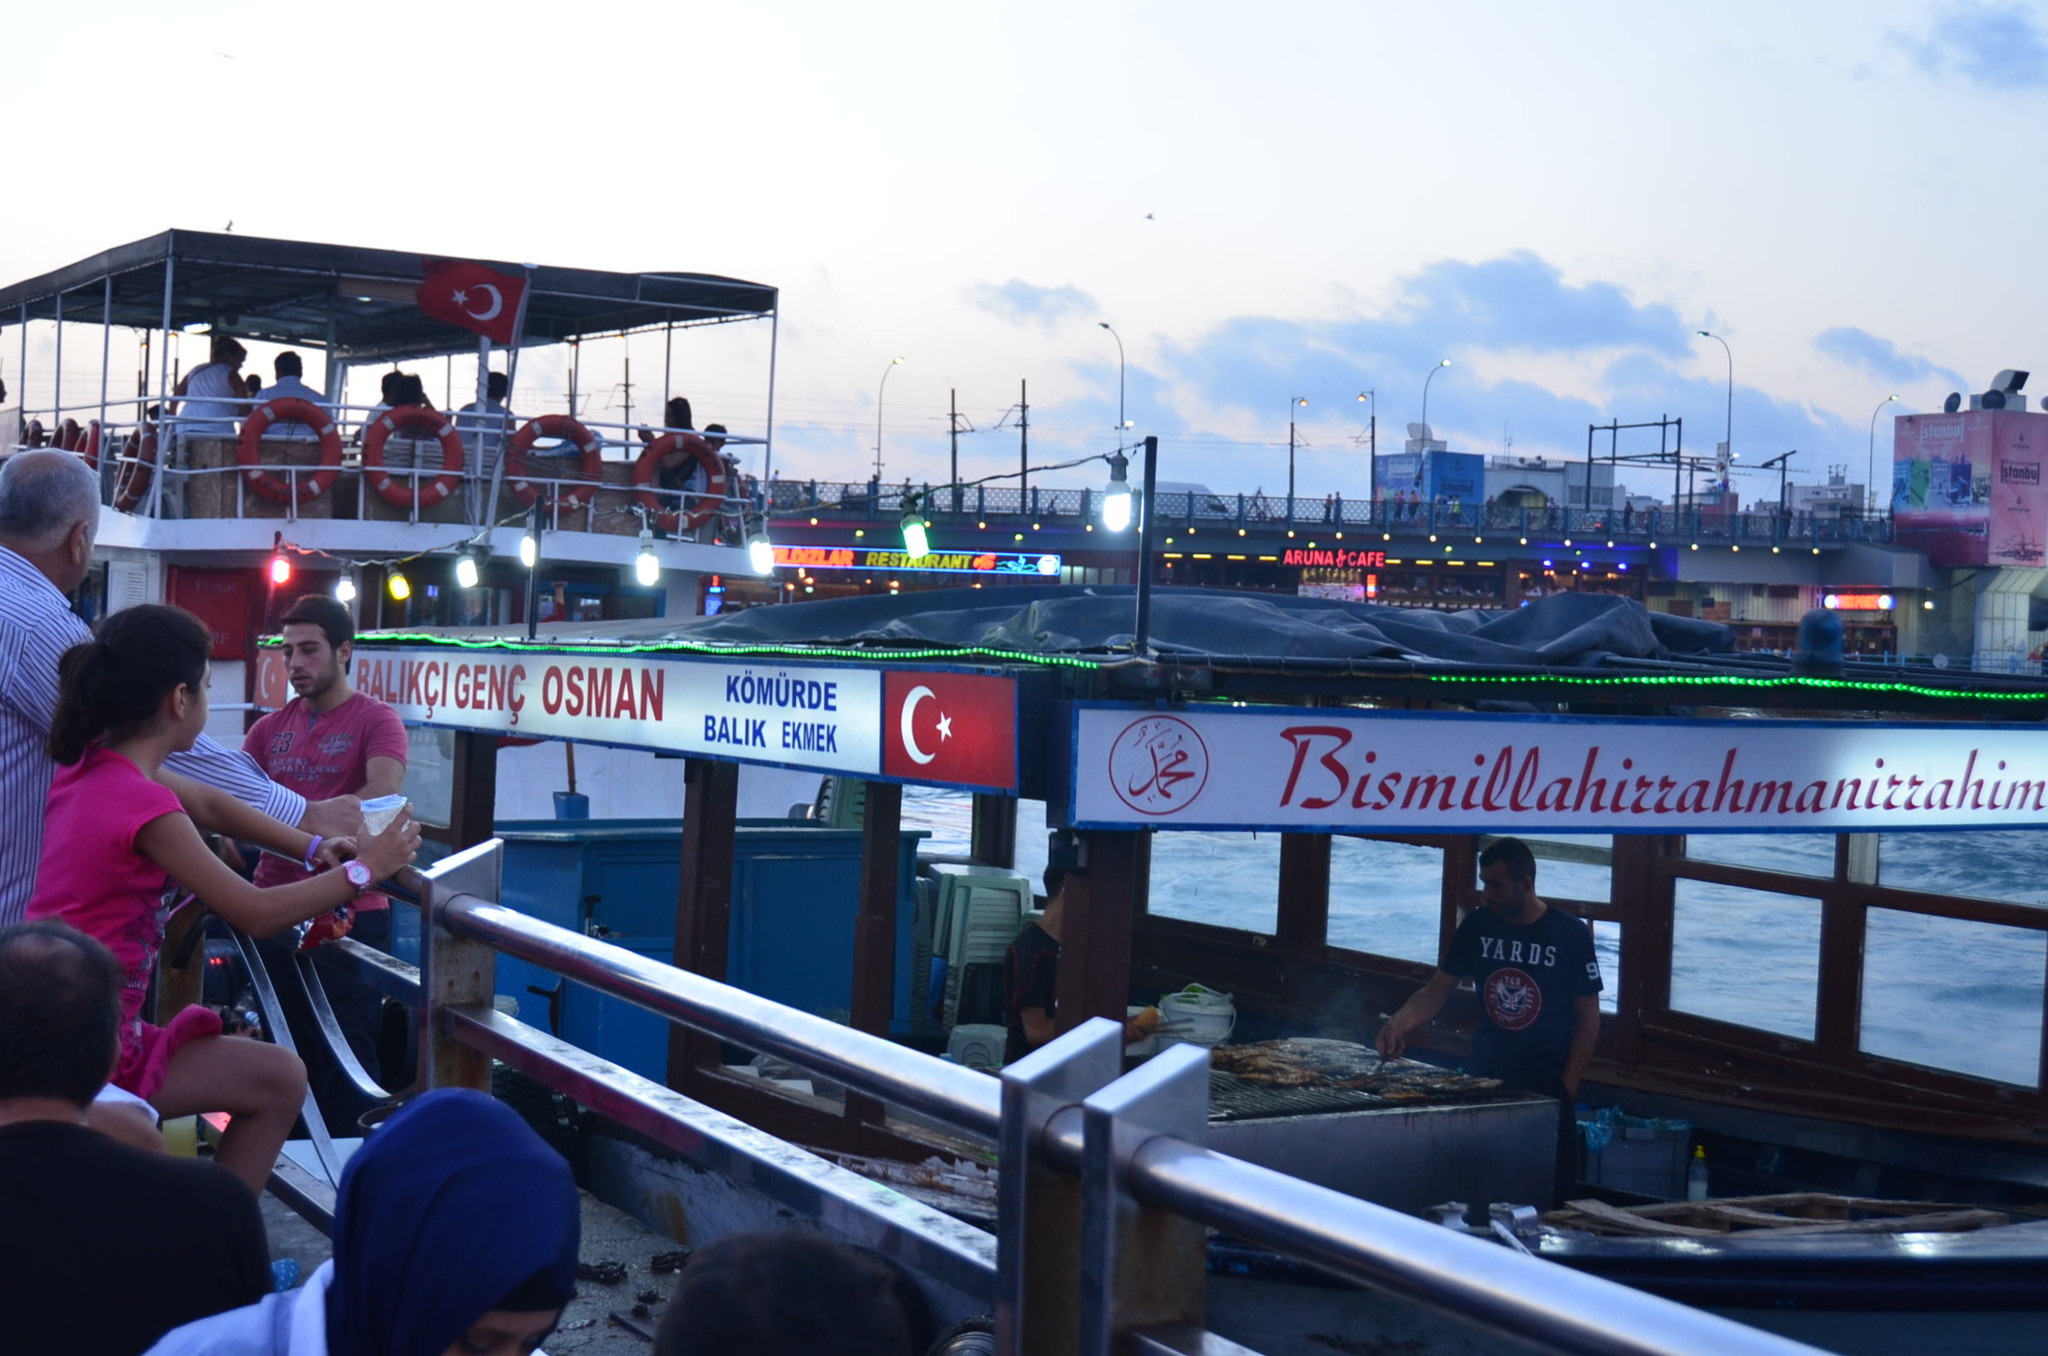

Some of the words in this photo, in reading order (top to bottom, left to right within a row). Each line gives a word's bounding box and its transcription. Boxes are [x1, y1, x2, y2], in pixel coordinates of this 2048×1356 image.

[866, 551, 972, 569] RESTAURANT
[1283, 549, 1334, 565] ARUNA
[1347, 551, 1385, 567] CAFE
[356, 658, 449, 719] BALIKÇI
[454, 663, 526, 725] GENÇ
[542, 665, 664, 721] OSMAN
[726, 669, 837, 711] KÖMÜRDE
[270, 732, 295, 754] 23
[704, 714, 766, 748] BALIK
[782, 720, 837, 753] EKMEK
[1480, 936, 1556, 967] YARDS
